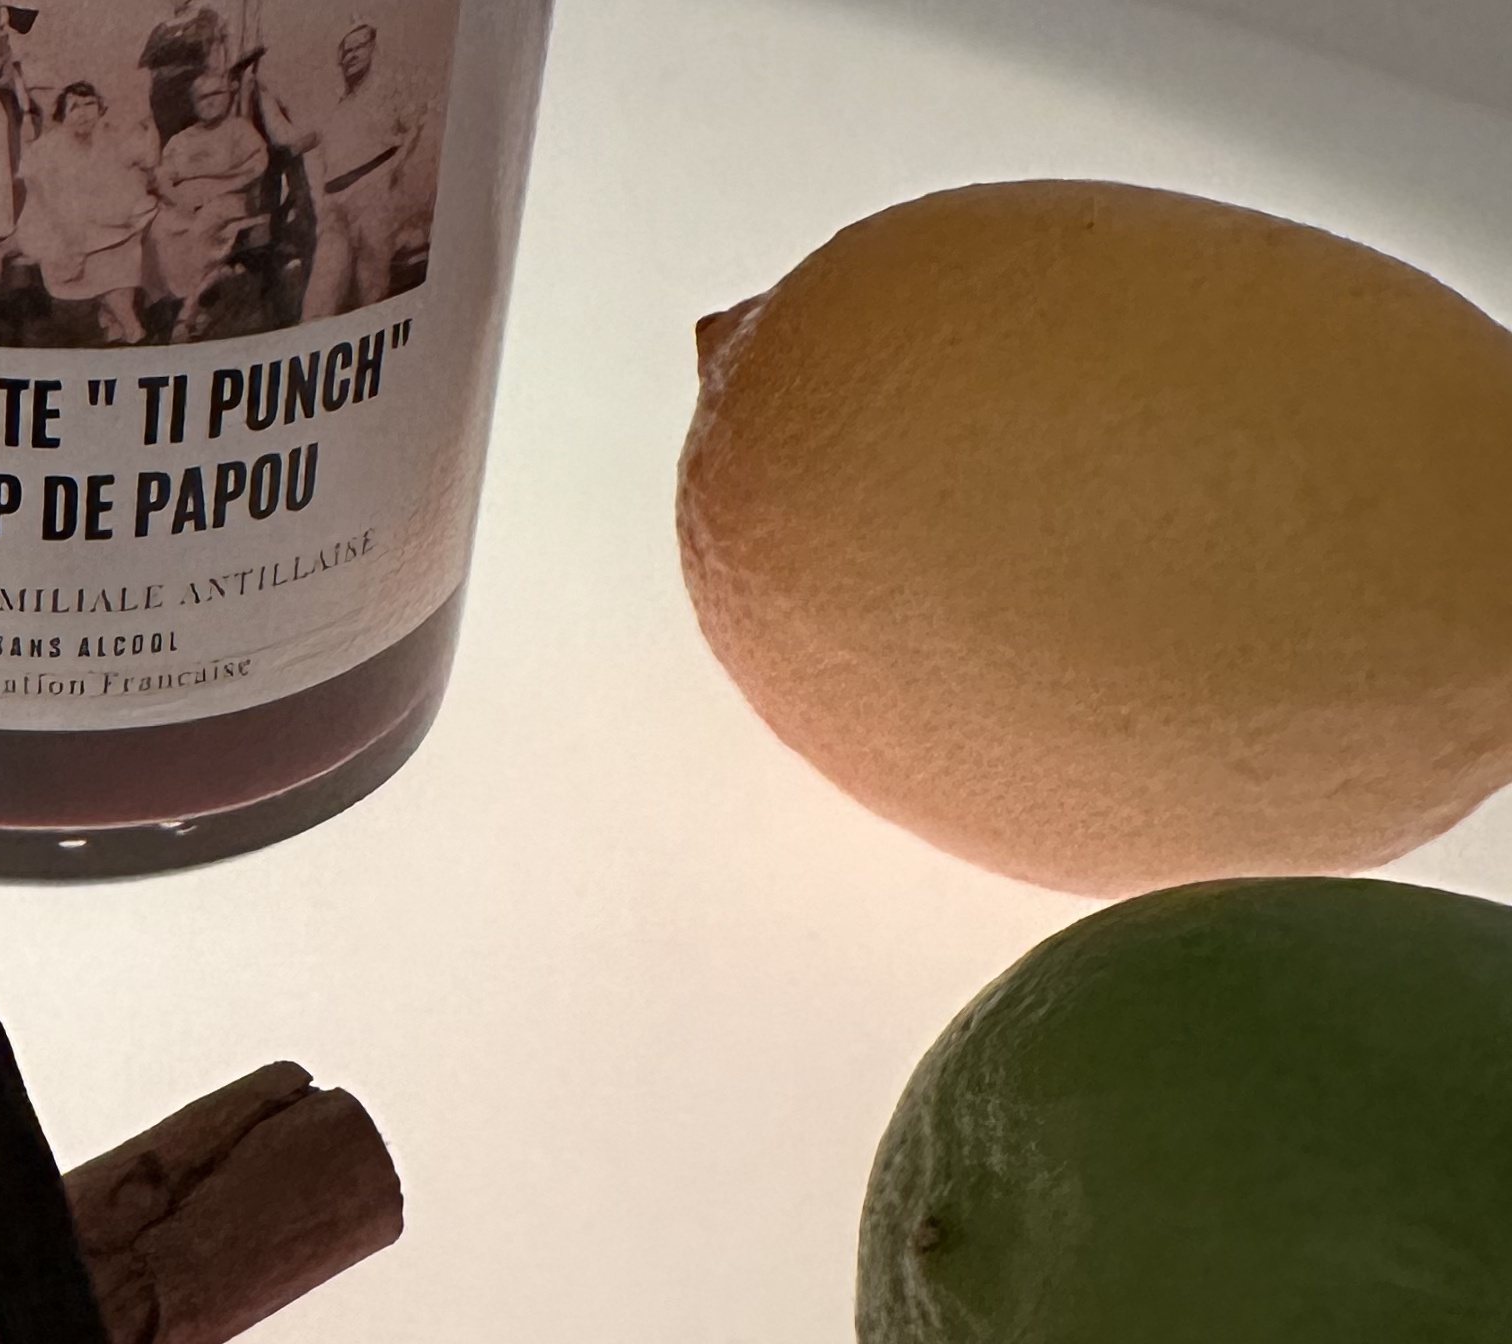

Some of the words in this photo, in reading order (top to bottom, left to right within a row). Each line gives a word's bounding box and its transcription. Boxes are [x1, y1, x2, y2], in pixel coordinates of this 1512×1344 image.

[137, 374, 188, 446] TI
[208, 317, 414, 439] PUNCH"
[41, 473, 115, 542] DE
[133, 441, 320, 539] PAPOU
[178, 526, 380, 606] ANTILLAISE
[77, 630, 179, 658] ALCOOL
